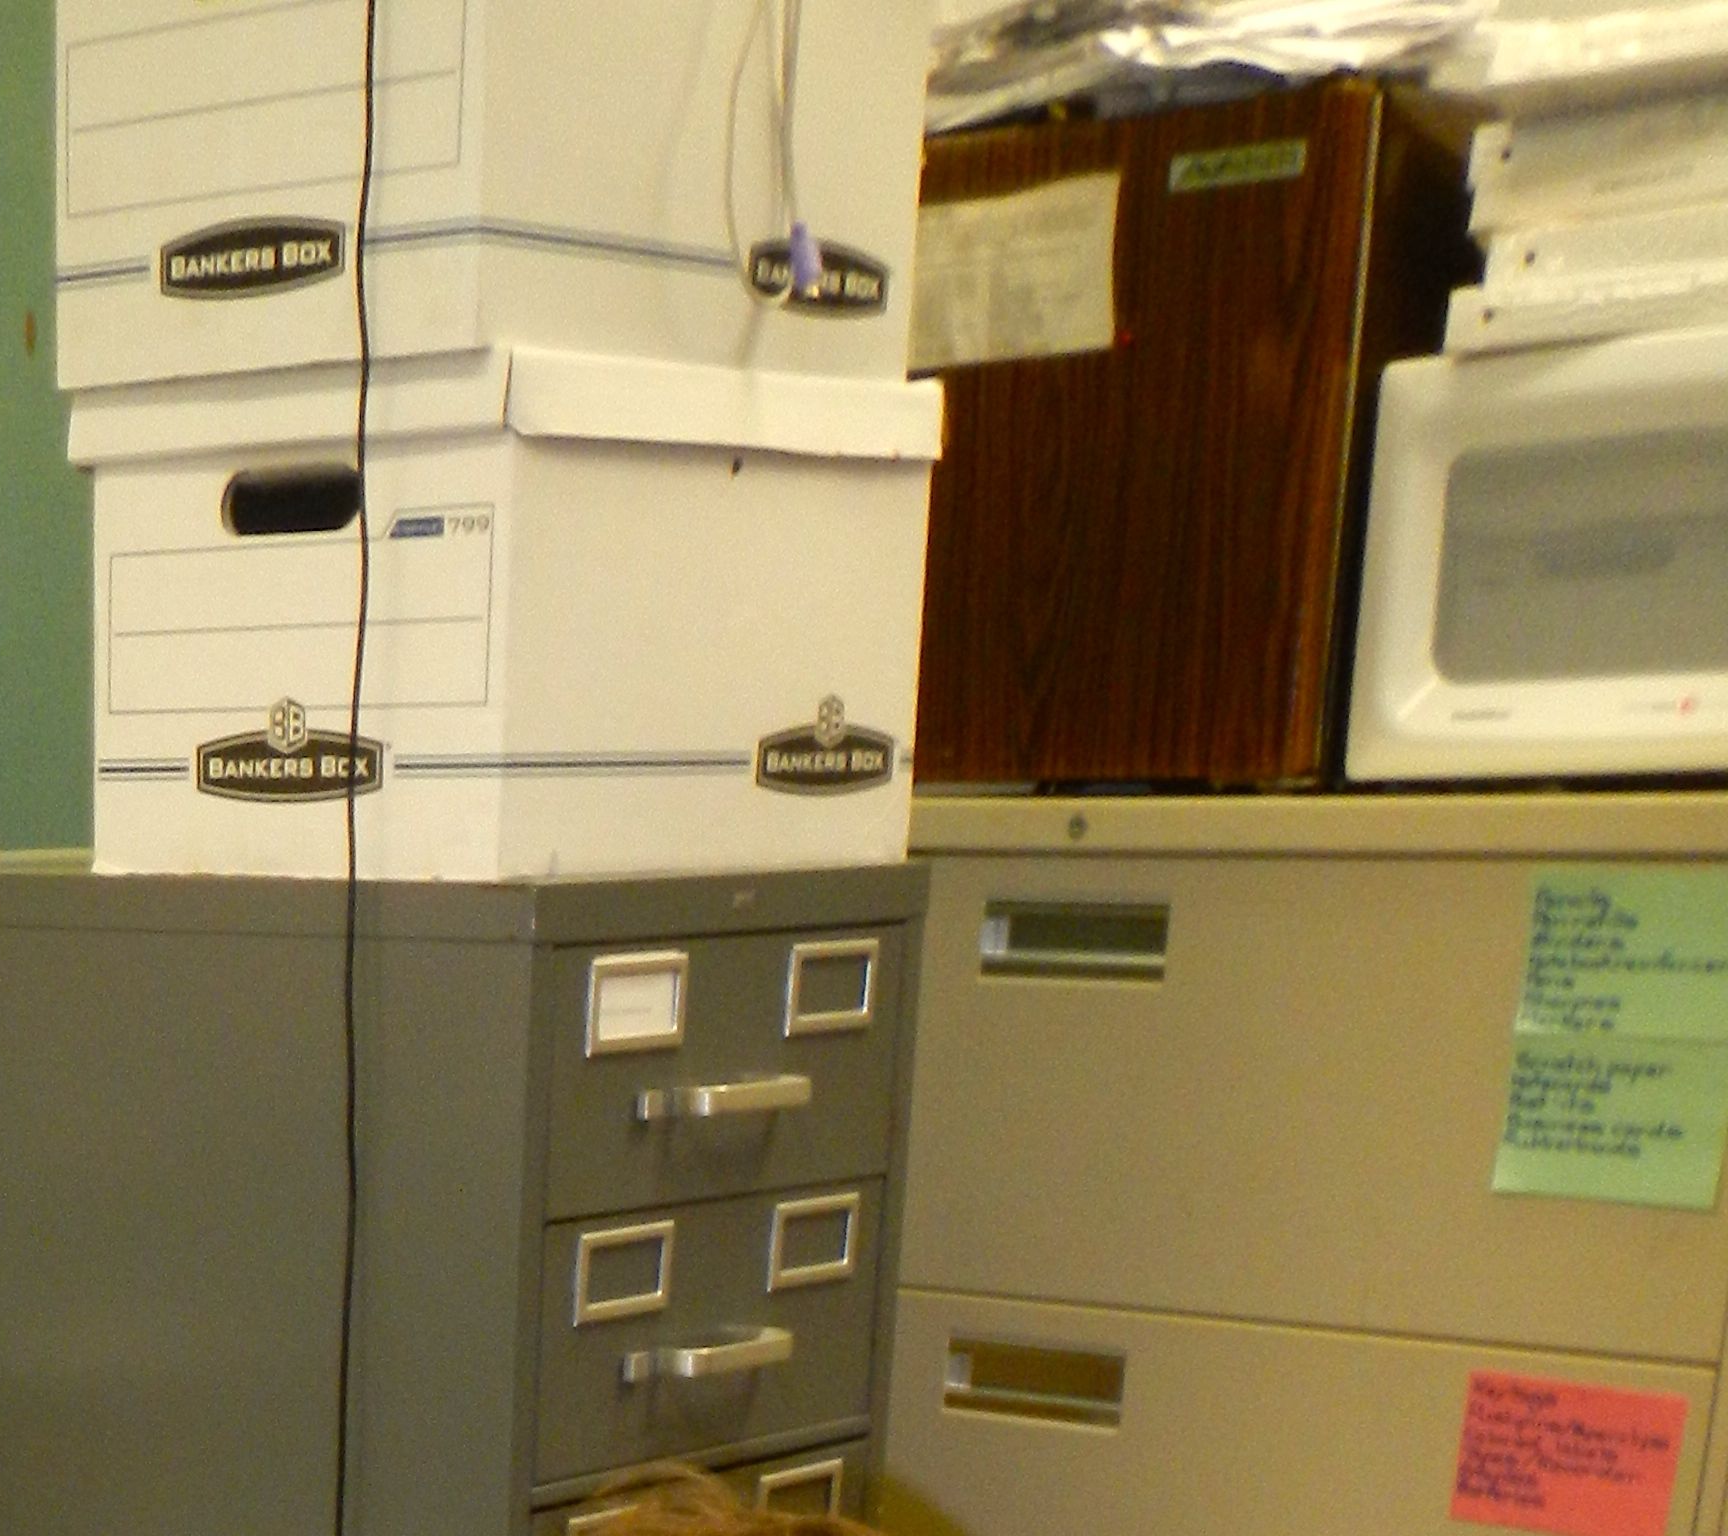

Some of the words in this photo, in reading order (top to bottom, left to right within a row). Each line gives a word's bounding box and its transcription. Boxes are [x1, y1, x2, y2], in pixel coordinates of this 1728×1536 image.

[171, 245, 276, 281] BANKERS
[282, 239, 332, 267] BOX
[844, 269, 880, 298] BOX
[208, 756, 314, 779] BANKERS
[320, 755, 370, 778] BOX
[766, 750, 848, 773] BANKERS
[851, 748, 884, 771] BOX
